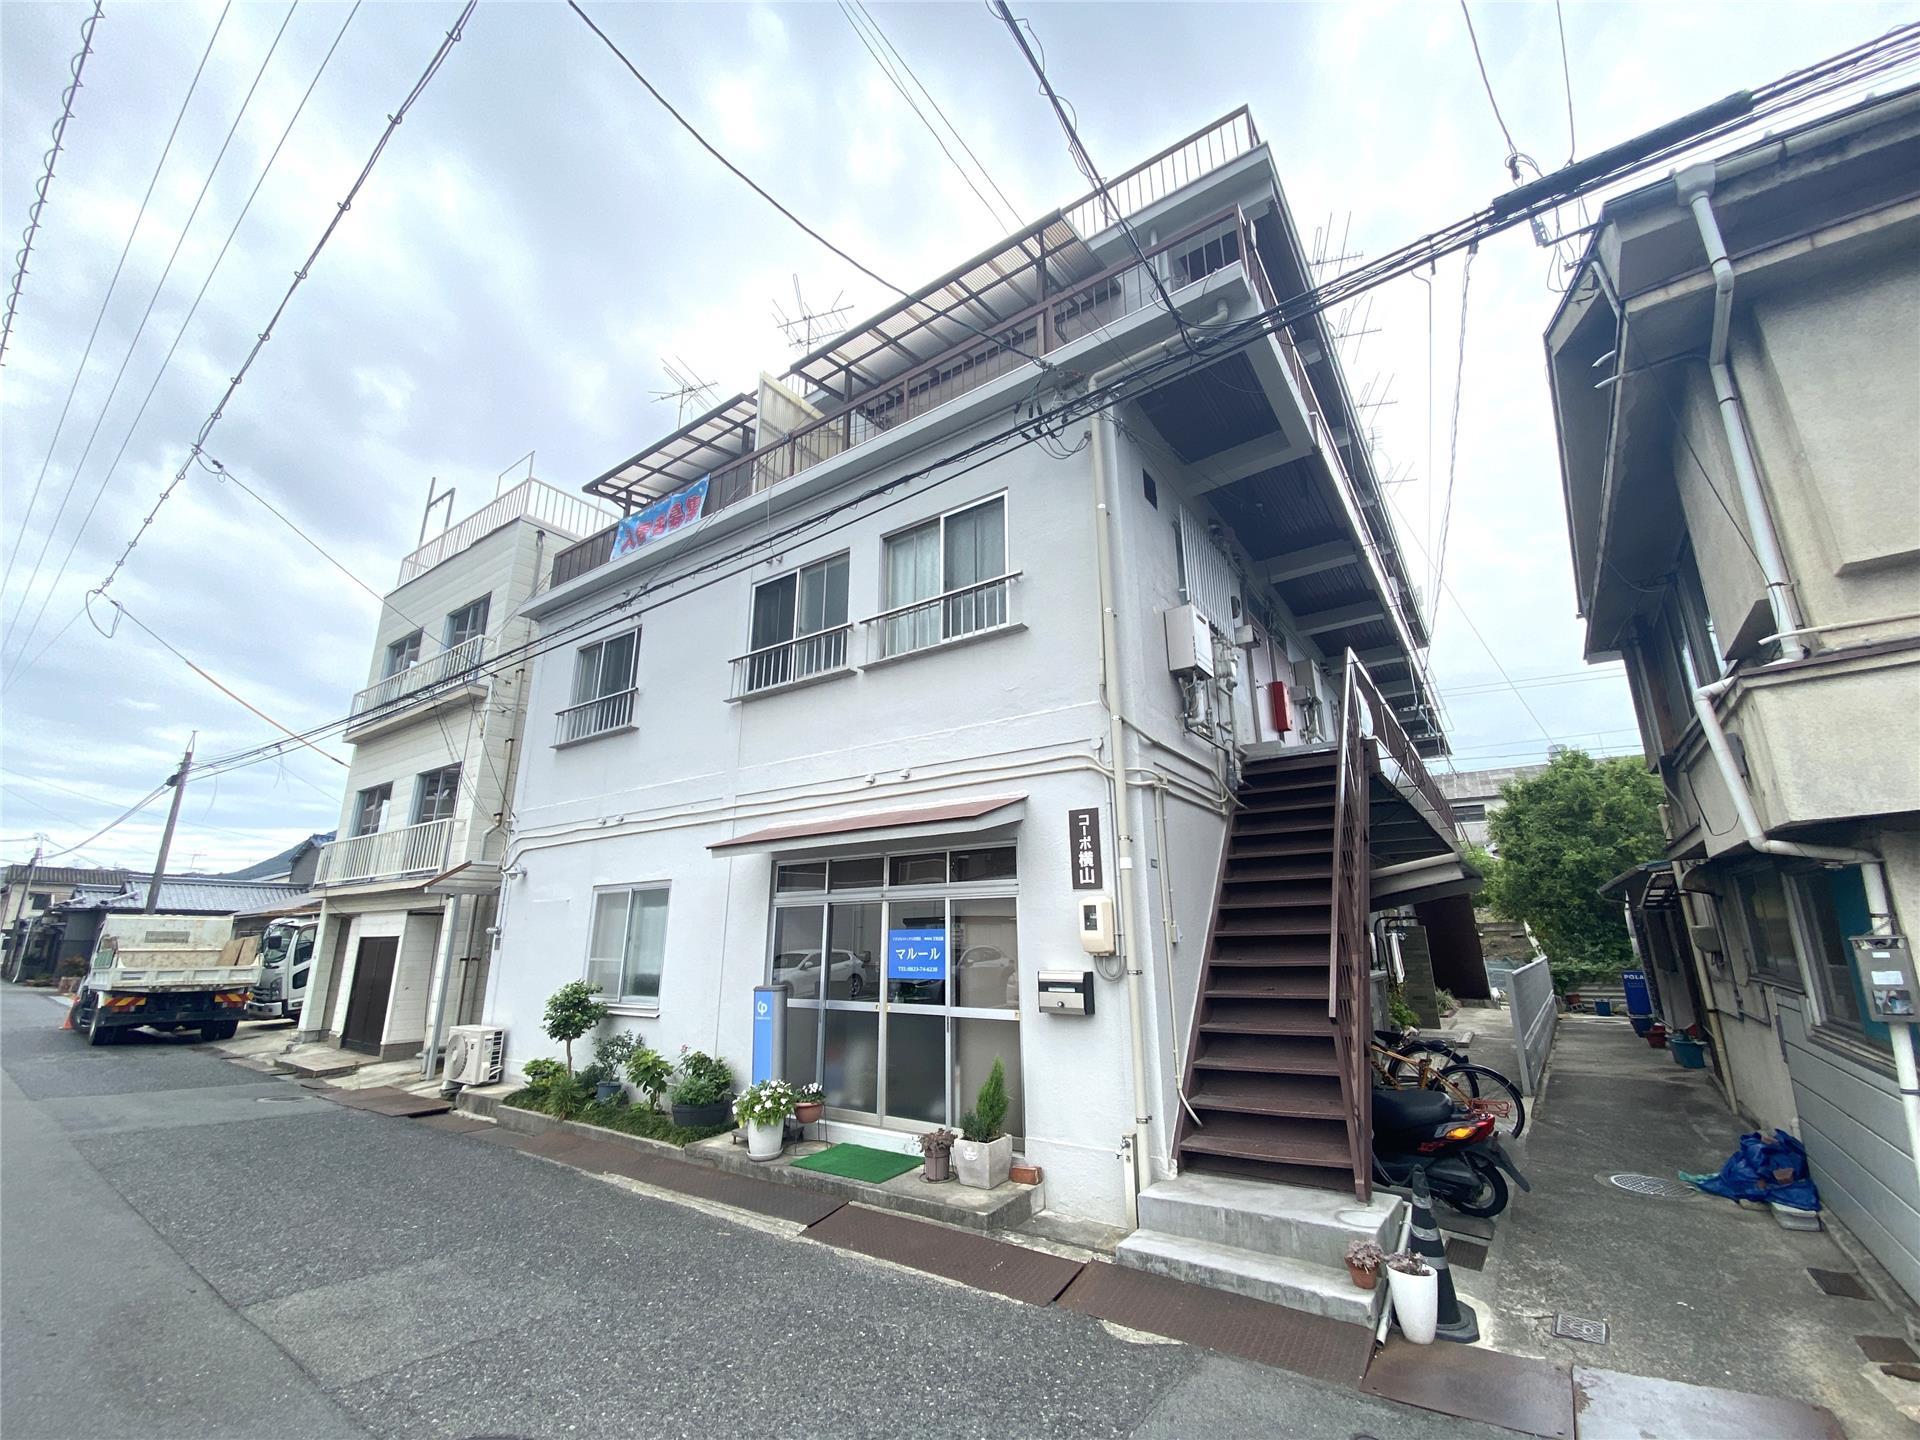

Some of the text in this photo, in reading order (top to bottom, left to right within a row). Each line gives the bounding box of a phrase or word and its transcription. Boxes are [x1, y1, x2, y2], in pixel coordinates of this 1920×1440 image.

[1078, 814, 1095, 884] コーポ横山
[895, 947, 941, 960] マルール
